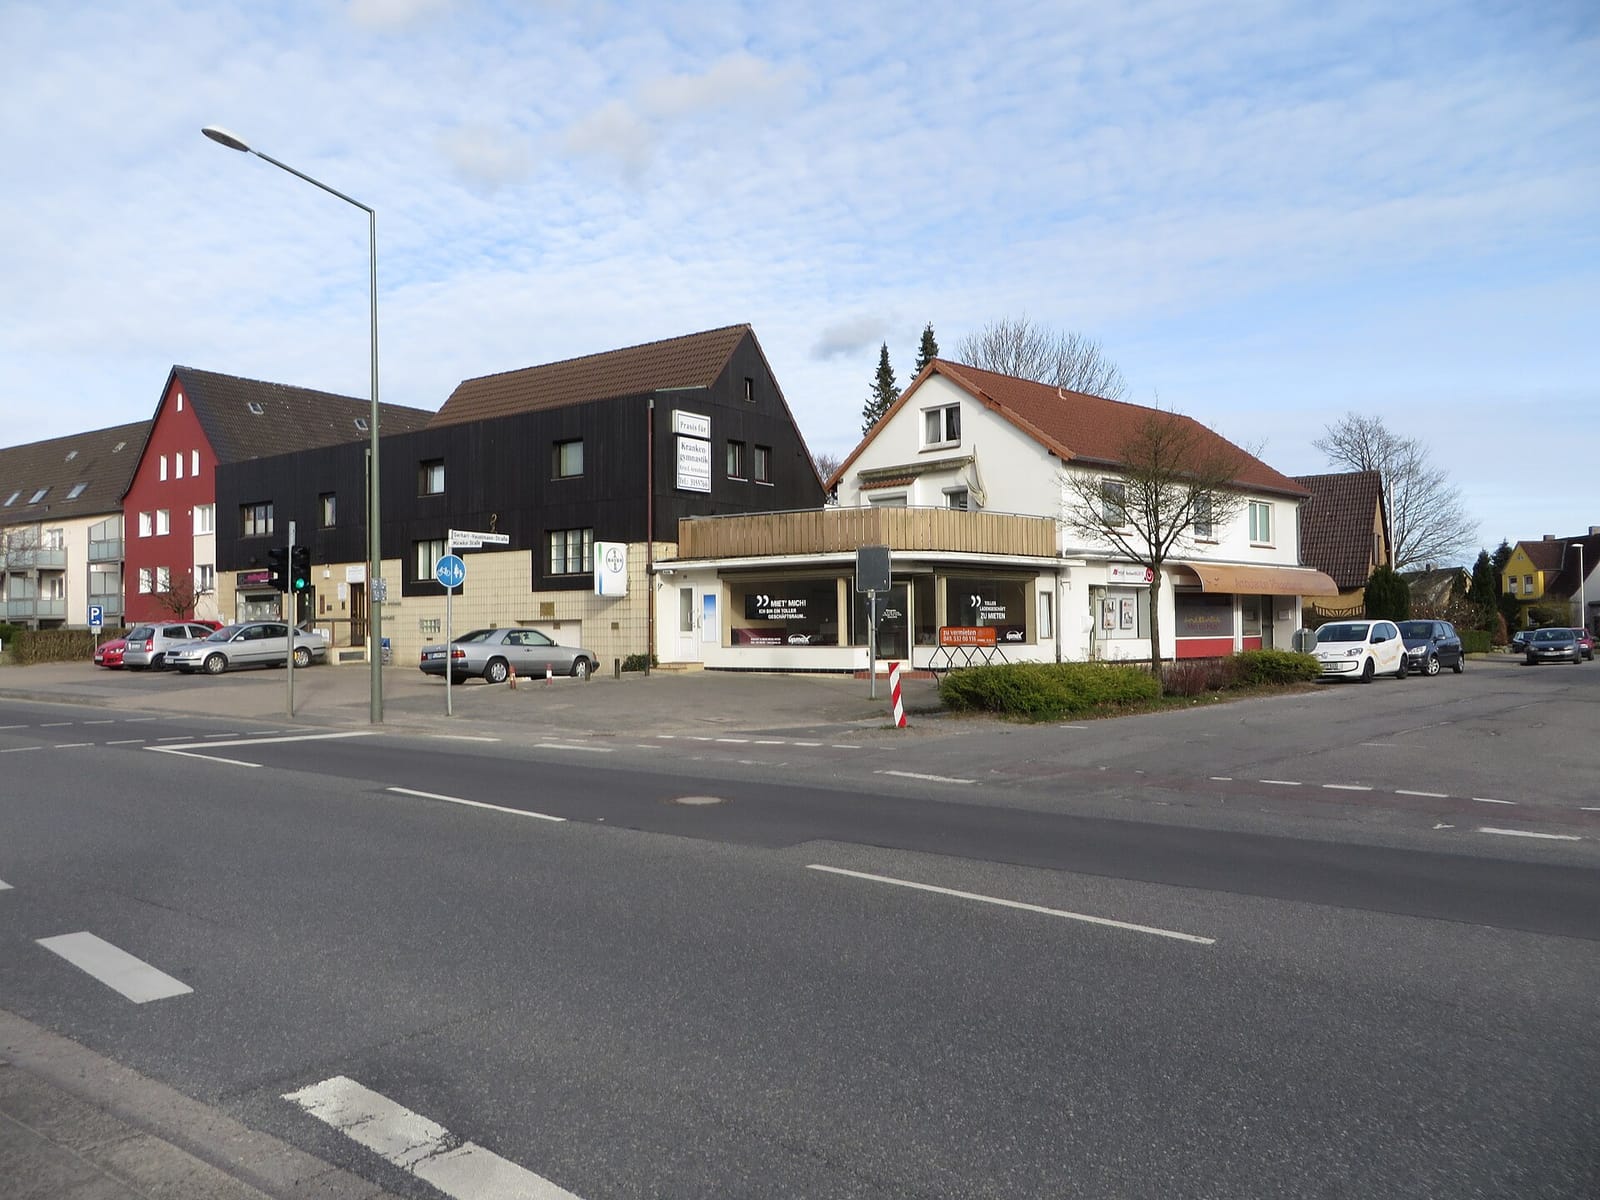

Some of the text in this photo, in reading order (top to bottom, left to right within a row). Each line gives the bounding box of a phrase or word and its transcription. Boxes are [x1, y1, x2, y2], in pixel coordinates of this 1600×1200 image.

[788, 599, 807, 607] MICH!
[91, 607, 100, 620] P
[987, 612, 1006, 620] MIETEN
[949, 628, 977, 636] vermieten
